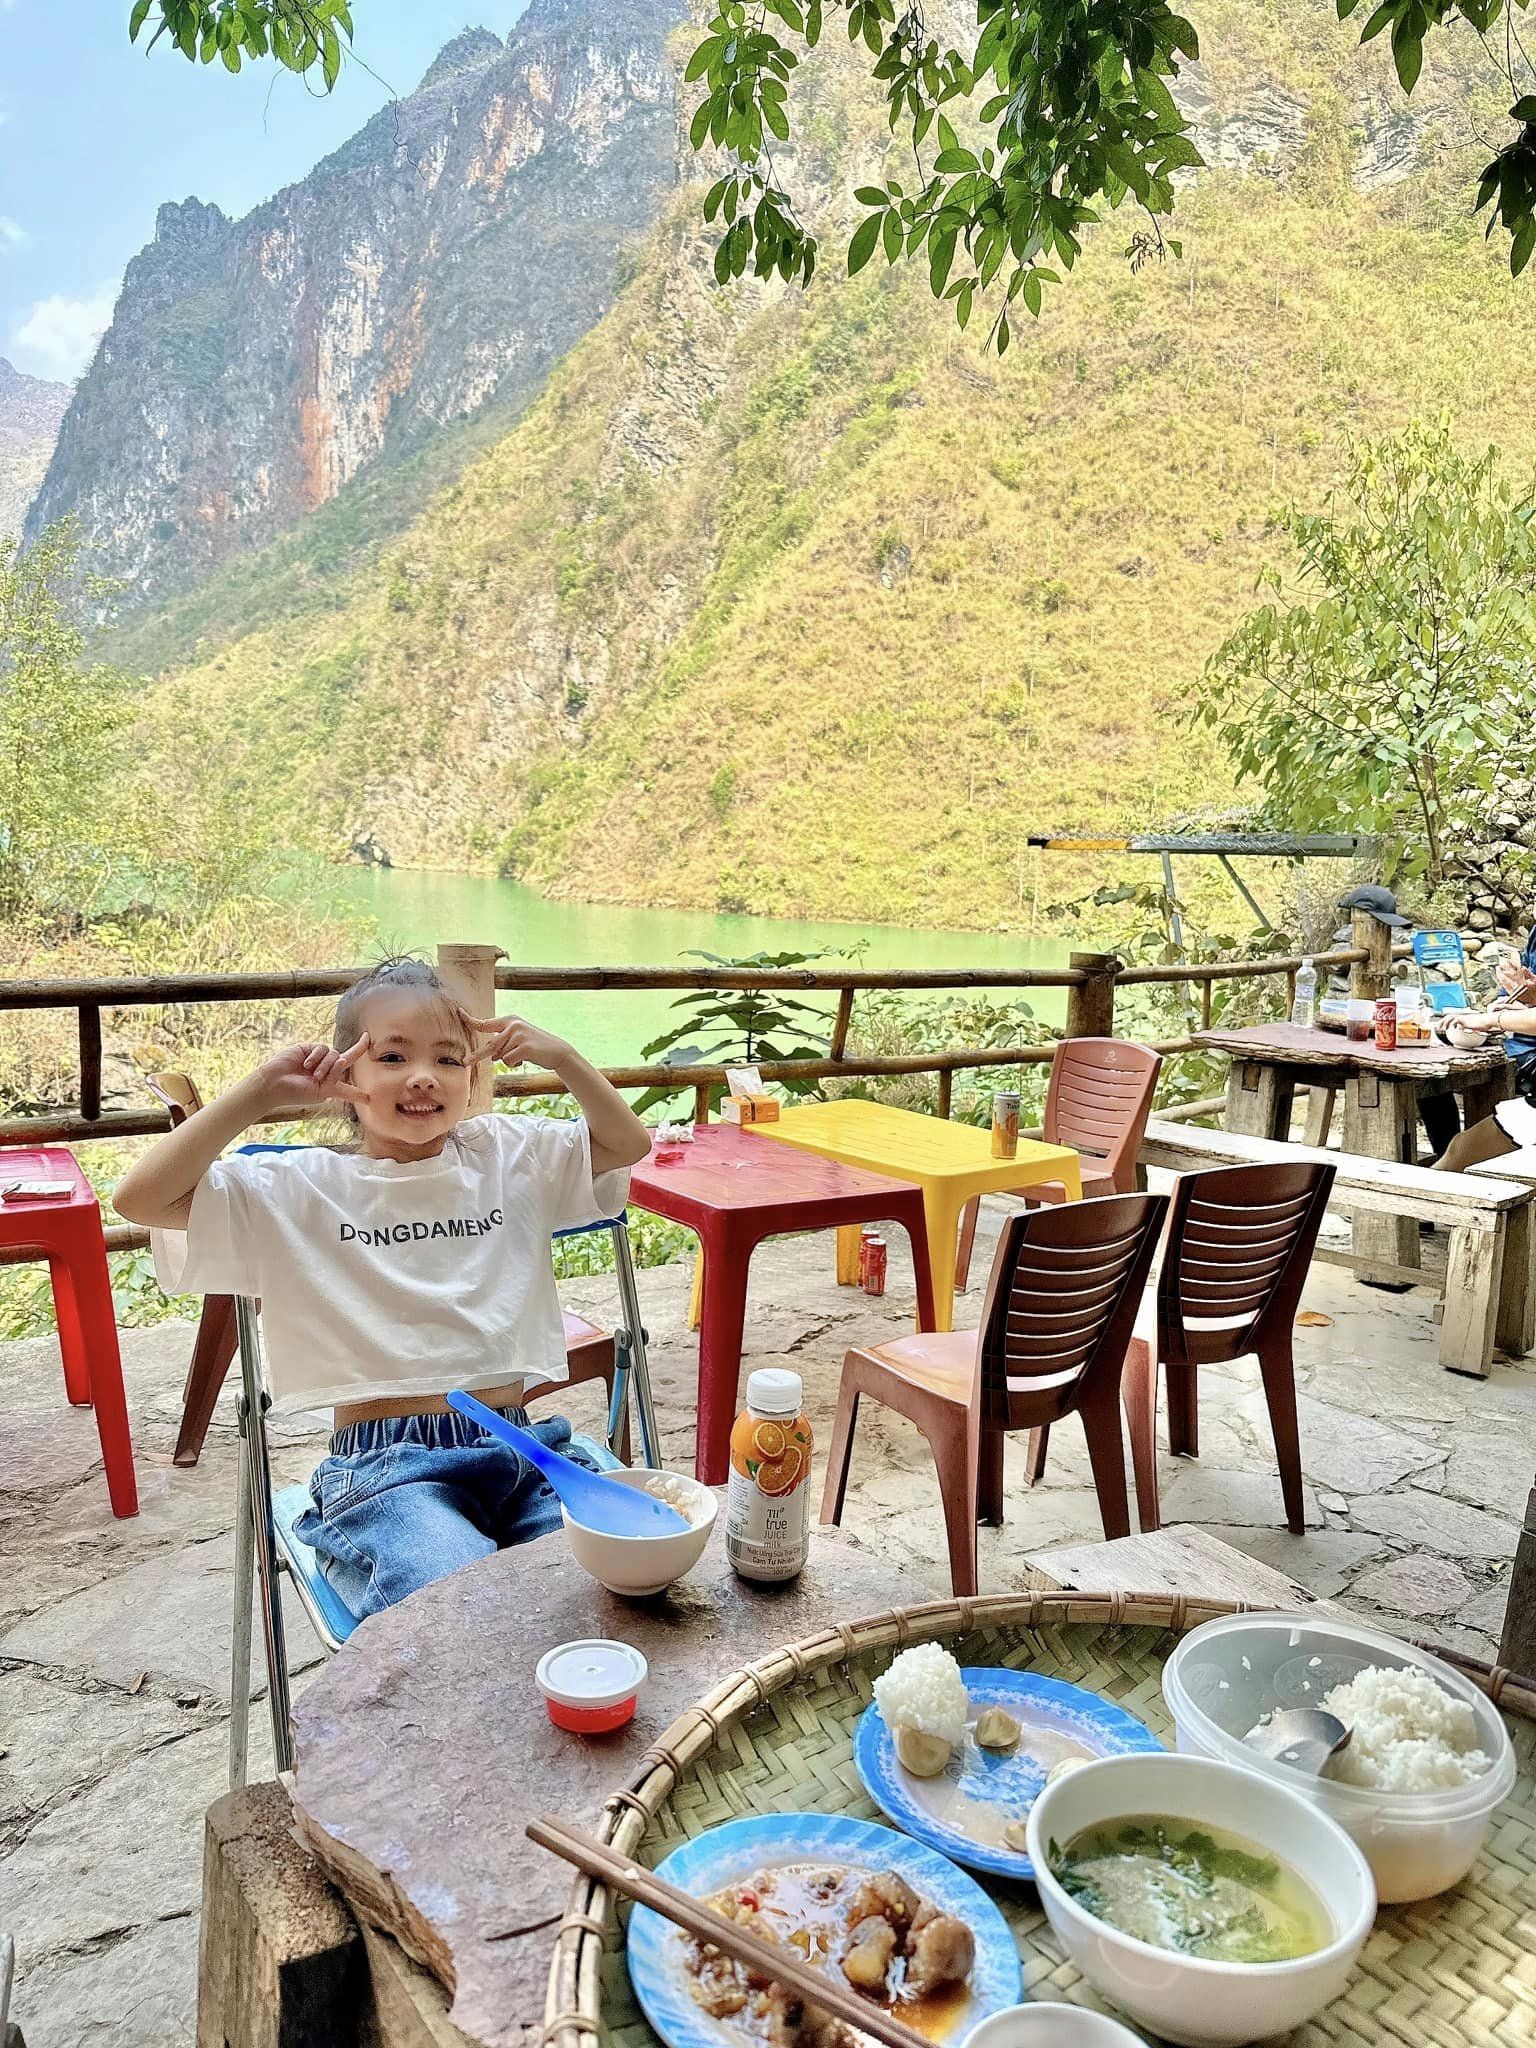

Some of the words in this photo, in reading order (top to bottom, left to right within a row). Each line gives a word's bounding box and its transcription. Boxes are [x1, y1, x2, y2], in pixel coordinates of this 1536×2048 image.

[340, 1208, 503, 1246] DONGDAMENG
[767, 1508, 780, 1518] TH
[766, 1519, 788, 1530] true
[764, 1530, 788, 1540] JUICE
[763, 1540, 781, 1549] milk
